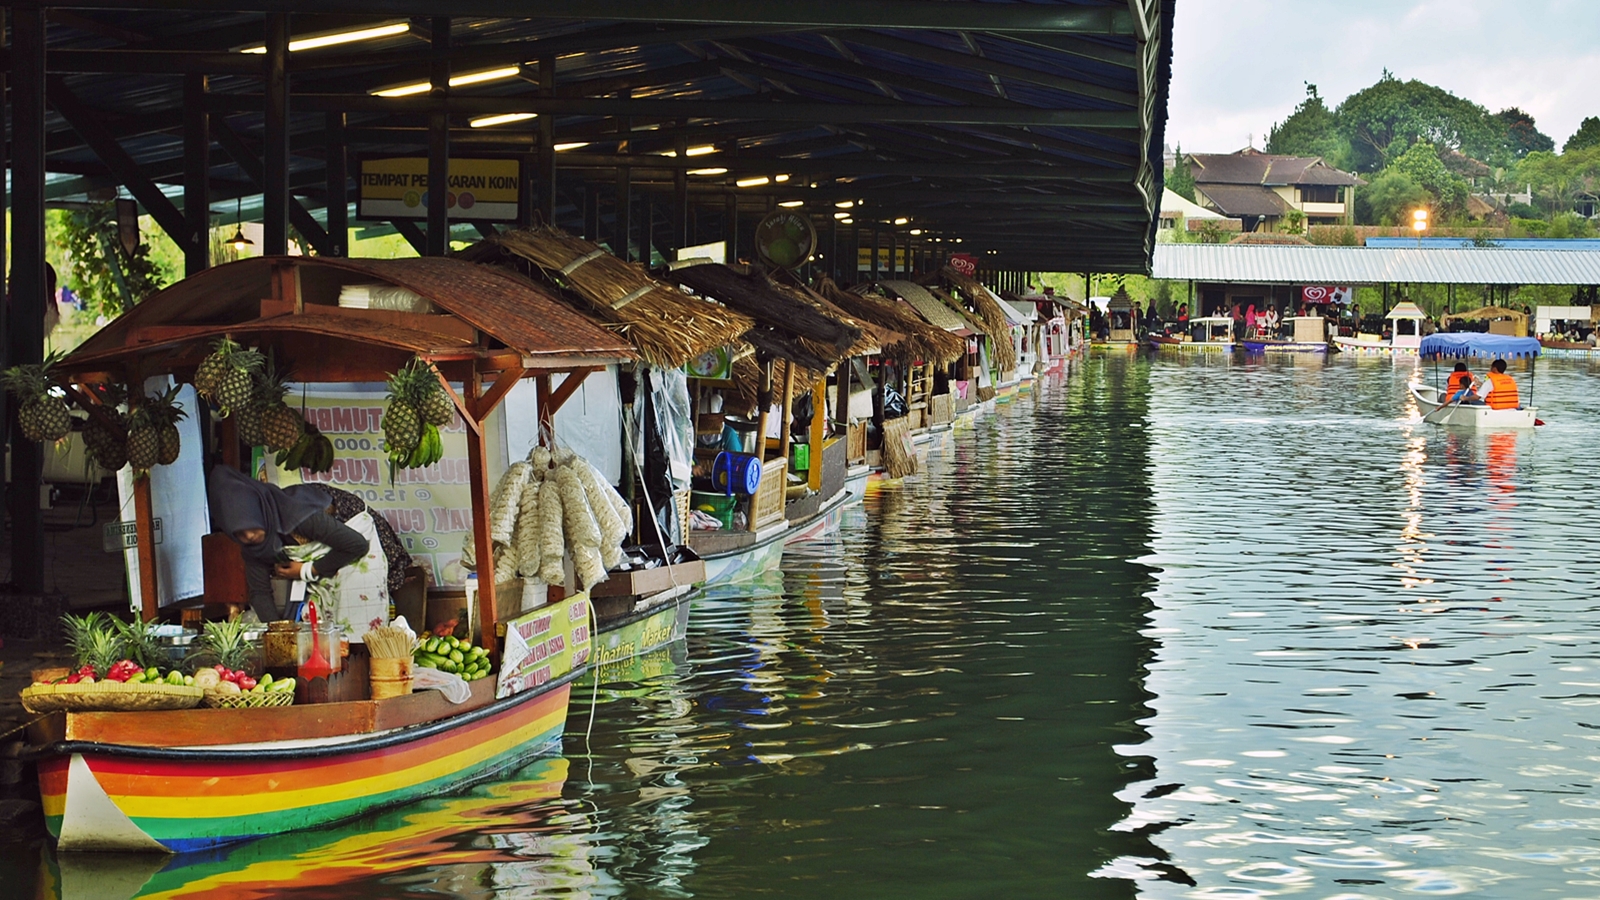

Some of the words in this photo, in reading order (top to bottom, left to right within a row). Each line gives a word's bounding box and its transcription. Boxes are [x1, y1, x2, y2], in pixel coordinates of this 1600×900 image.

[361, 173, 409, 187] TEMPAT
[411, 174, 486, 189] PEKARAN
[489, 176, 518, 190] KOIN
[192, 232, 199, 244] 4
[333, 245, 340, 256] 5
[593, 641, 635, 664] Floating
[641, 624, 672, 649] Market
